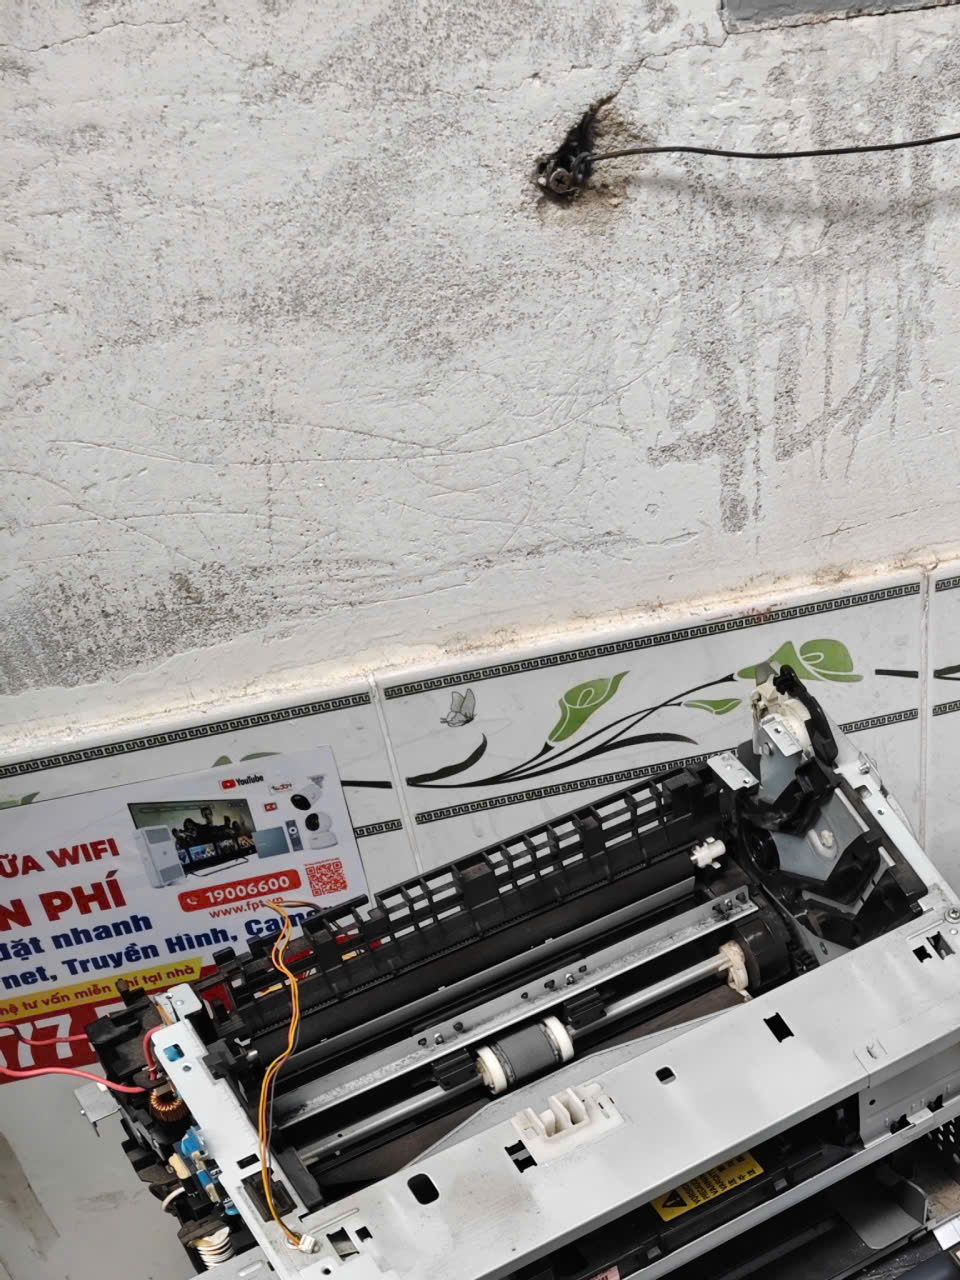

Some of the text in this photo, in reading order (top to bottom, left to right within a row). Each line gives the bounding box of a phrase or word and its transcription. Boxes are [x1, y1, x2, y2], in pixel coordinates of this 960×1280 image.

[236, 774, 264, 786] YouTube
[46, 838, 120, 868] WIFI
[38, 869, 127, 922] PHÍ
[206, 876, 290, 904] 19006600
[51, 914, 152, 950] nhanh
[61, 942, 160, 976] Truyền
[165, 928, 238, 953] Hình,
[22, 1000, 38, 1011] tư
[41, 992, 71, 1007] vấn
[74, 984, 112, 1000] miễn
[142, 971, 162, 985] tại
[166, 965, 195, 979] nhà
